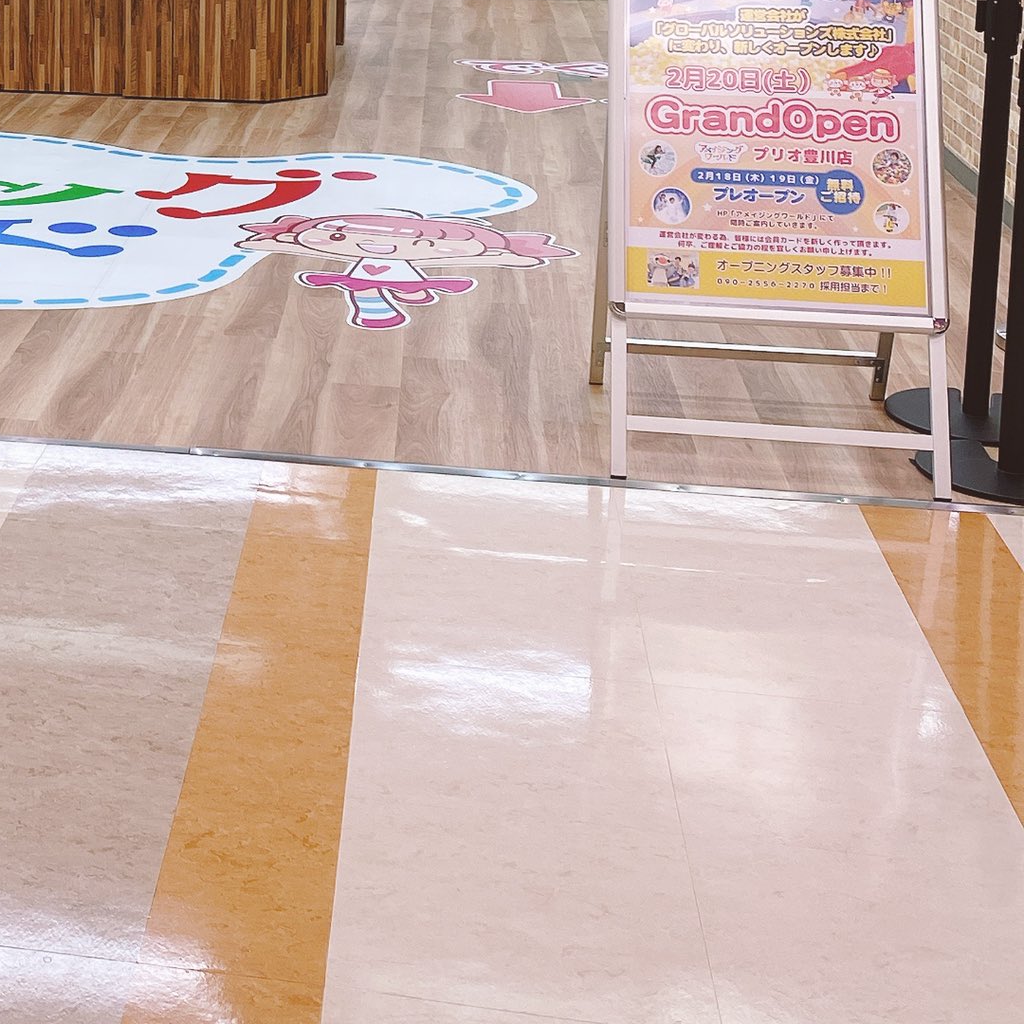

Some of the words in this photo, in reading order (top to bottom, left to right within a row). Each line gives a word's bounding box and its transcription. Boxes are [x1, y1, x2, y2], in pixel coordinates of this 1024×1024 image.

[739, 8, 807, 23] 運営会社が
[666, 67, 811, 94] 2月20日(土)
[753, 147, 853, 165] プリオ豊川店
[826, 179, 853, 193] 無料
[713, 187, 805, 204] プレオープン
[820, 192, 861, 205] ご招待
